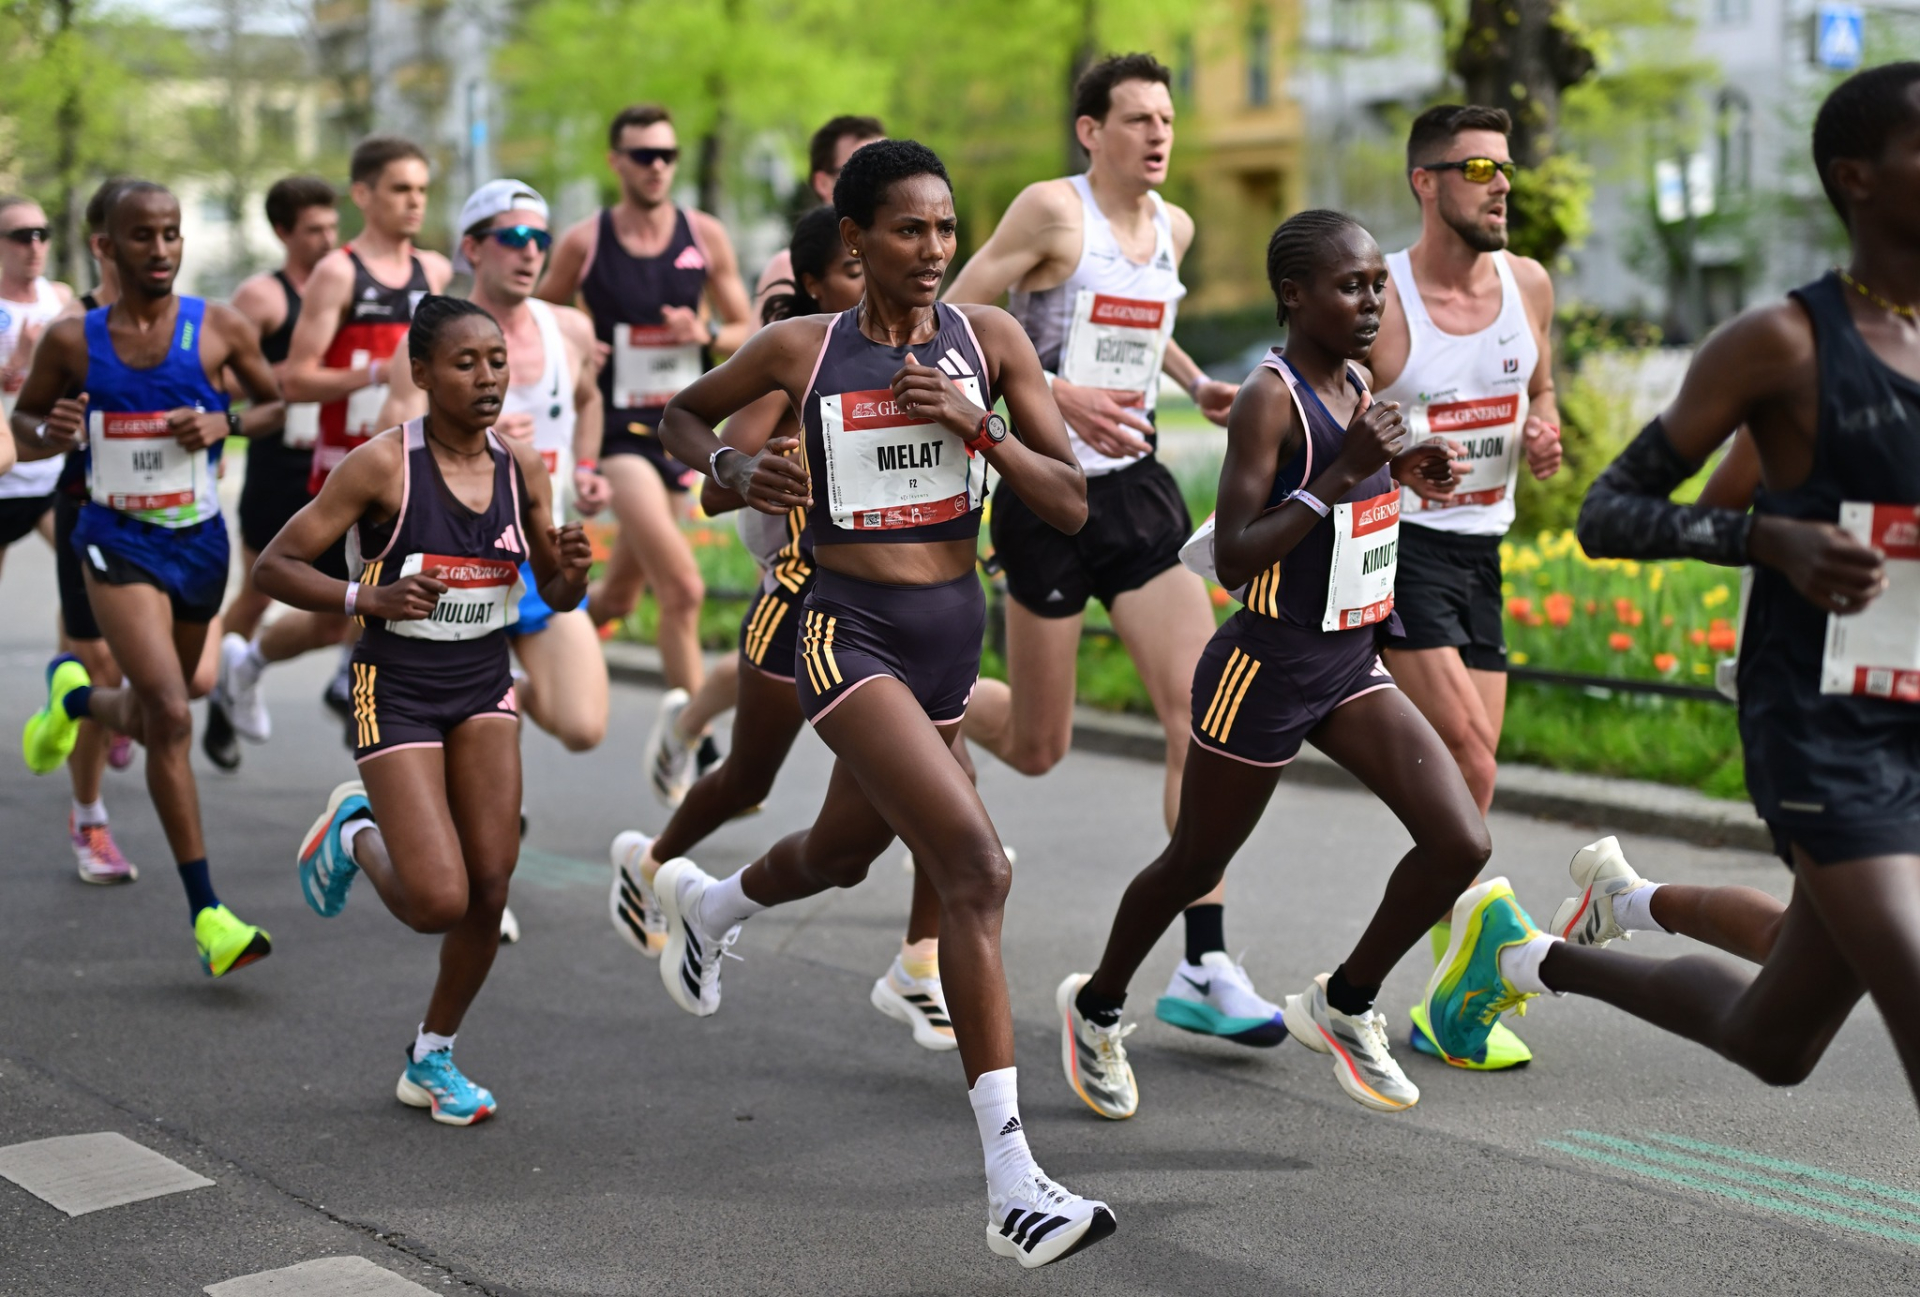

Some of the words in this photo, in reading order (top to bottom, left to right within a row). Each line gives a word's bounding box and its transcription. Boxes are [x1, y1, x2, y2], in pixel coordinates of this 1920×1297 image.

[1455, 403, 1511, 422] GENERALI
[877, 440, 943, 472] MELAT
[909, 479, 918, 488] F2
[450, 565, 511, 581] GENERALI
[429, 602, 494, 624] MULUAT
